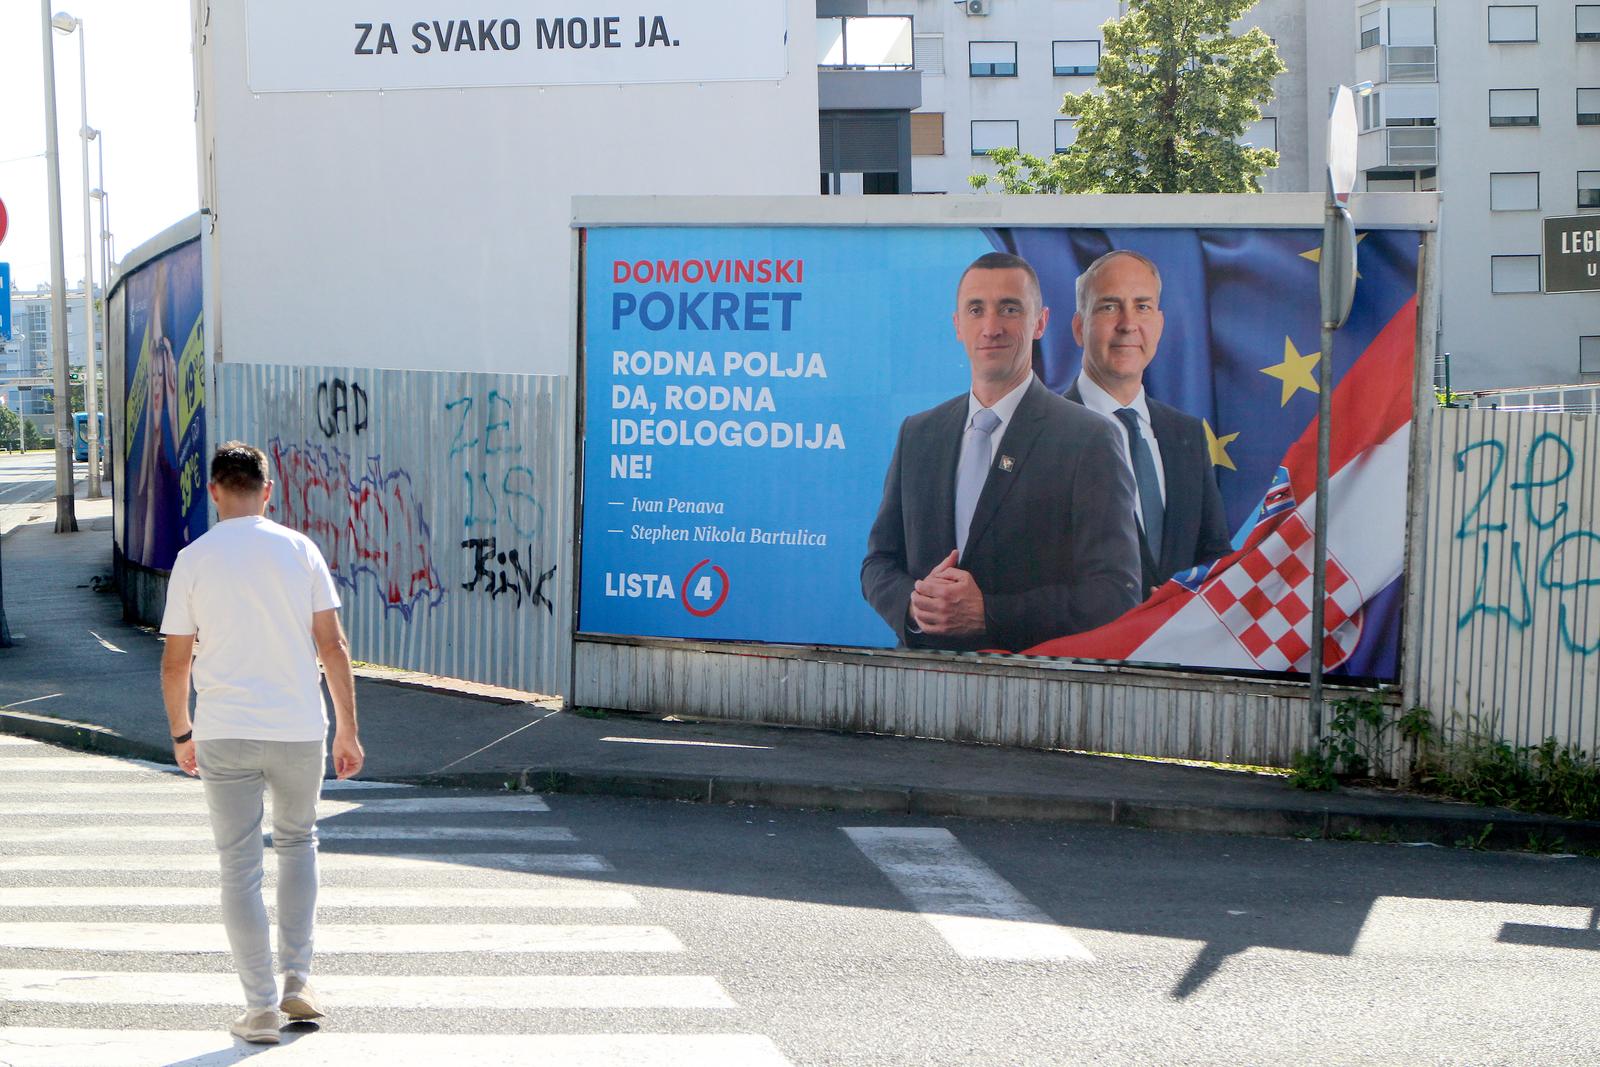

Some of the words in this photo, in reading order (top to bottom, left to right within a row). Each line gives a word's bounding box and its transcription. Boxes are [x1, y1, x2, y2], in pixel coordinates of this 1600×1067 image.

[354, 23, 398, 55] ZA
[411, 18, 521, 54] SVAKO
[536, 16, 621, 49] MOJE
[635, 15, 680, 48] JA.
[613, 259, 804, 284] DOMOVINSKI
[612, 291, 802, 331] POKRET
[612, 350, 717, 376] RODNA
[723, 351, 828, 378] POLJA
[611, 384, 657, 415] DA,
[665, 385, 776, 412] RODNA
[611, 419, 846, 449] IDEOLOGODIJA
[610, 455, 652, 479] NE!
[631, 497, 663, 513] Ivan
[667, 498, 724, 514] Penava
[631, 525, 689, 544] Stephen
[693, 527, 746, 543] Nikola
[750, 528, 827, 546] Bartulica
[605, 573, 675, 599] LISTA
[694, 576, 713, 600] 4
